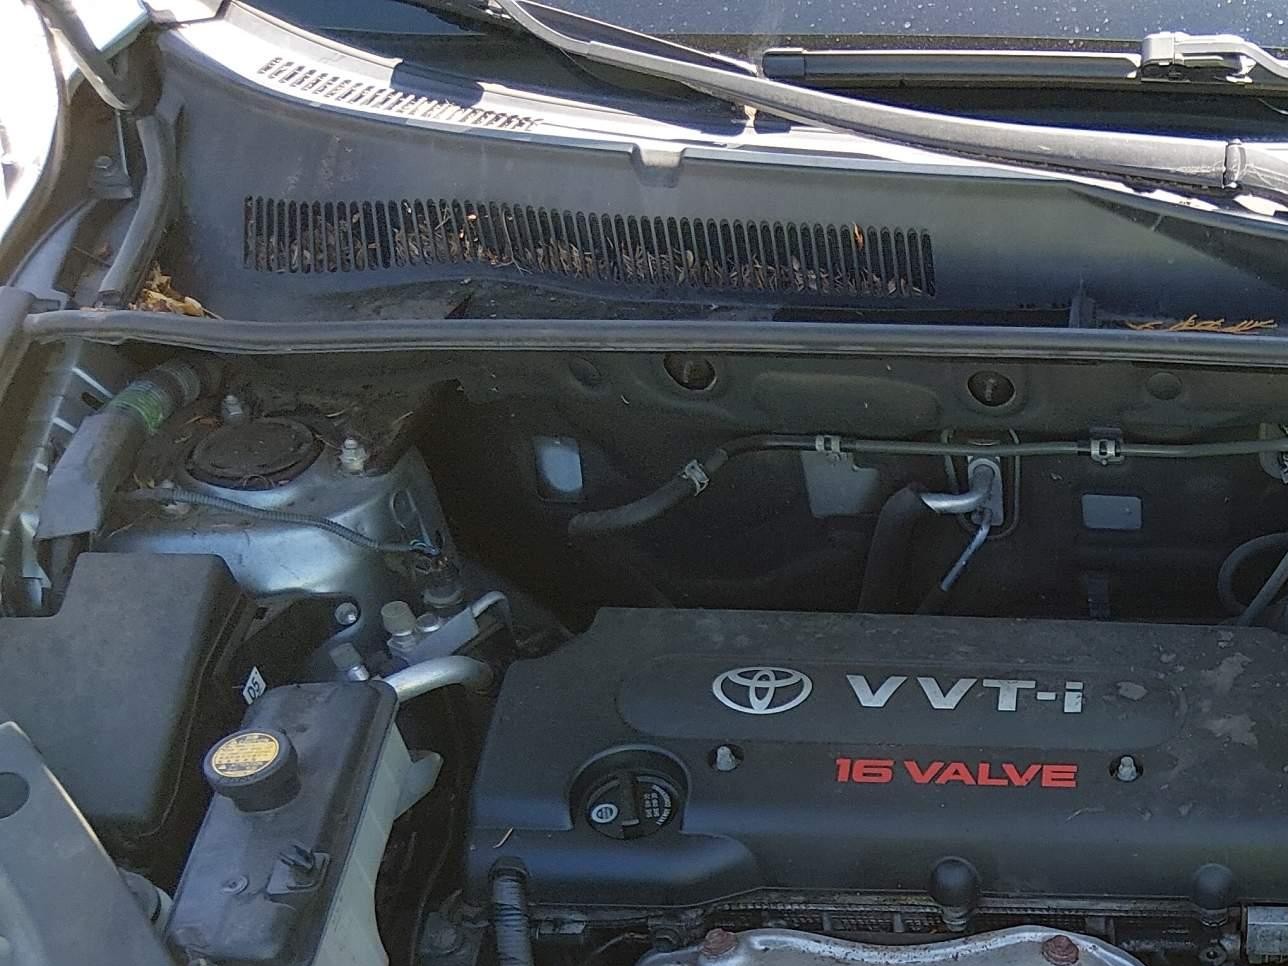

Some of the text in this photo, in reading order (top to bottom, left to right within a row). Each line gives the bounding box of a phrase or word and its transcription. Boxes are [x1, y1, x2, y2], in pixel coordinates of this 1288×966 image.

[845, 673, 1083, 713] VVT-i
[834, 757, 1078, 788] 16 VALVE
